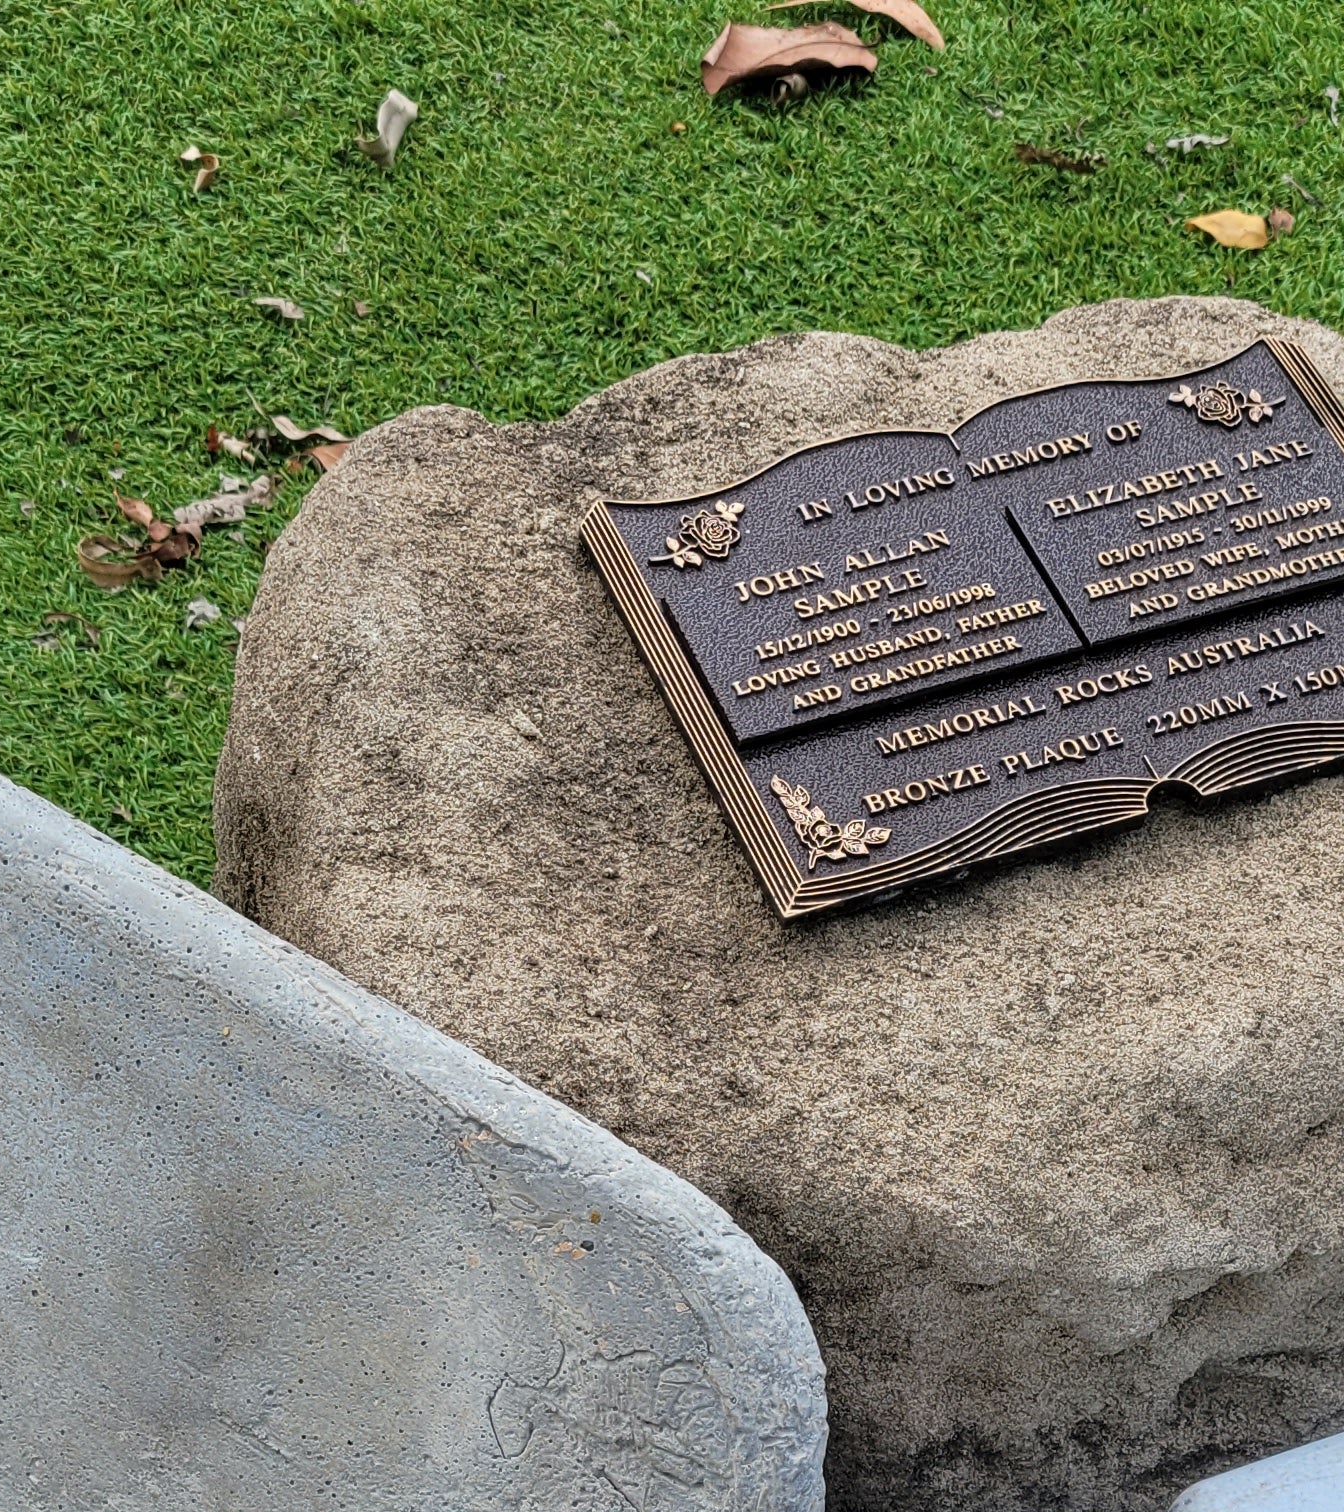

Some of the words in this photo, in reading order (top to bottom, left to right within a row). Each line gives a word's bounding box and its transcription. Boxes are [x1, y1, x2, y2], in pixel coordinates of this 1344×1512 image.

[797, 501, 831, 523] IN
[847, 468, 956, 509] LOVING
[966, 432, 1093, 480] MEMORY
[1107, 419, 1144, 444] OF
[1048, 457, 1225, 518] ELIZABETH
[1234, 440, 1314, 471] JANE
[1137, 483, 1263, 529] SAMPLE
[735, 560, 825, 603] JOHN
[844, 530, 951, 572] ALLAN
[1086, 559, 1195, 600] BELOVED
[1203, 540, 1269, 567] WIFE,
[1097, 526, 1205, 567] 03/07/1915
[1231, 497, 1332, 533] 30/11/1999
[755, 619, 862, 660] 15/12/1900
[887, 582, 997, 626] 23/06/1998
[795, 569, 928, 619] SAMPLE
[1129, 596, 1179, 619] AND
[732, 659, 822, 698] LOVING
[832, 627, 951, 670] HUSBAND,
[958, 600, 1047, 640] FATHER
[793, 685, 843, 711] AND
[852, 635, 1022, 694] GRANDFATHER
[876, 694, 1047, 756] MEMORIAL
[1056, 665, 1153, 704] ROCKS
[1167, 620, 1326, 676] AUSTRALIA
[865, 763, 992, 814] BRONZE
[1003, 727, 1124, 782] PLAQUE
[1147, 691, 1253, 734] 220MM
[1266, 681, 1286, 701] X
